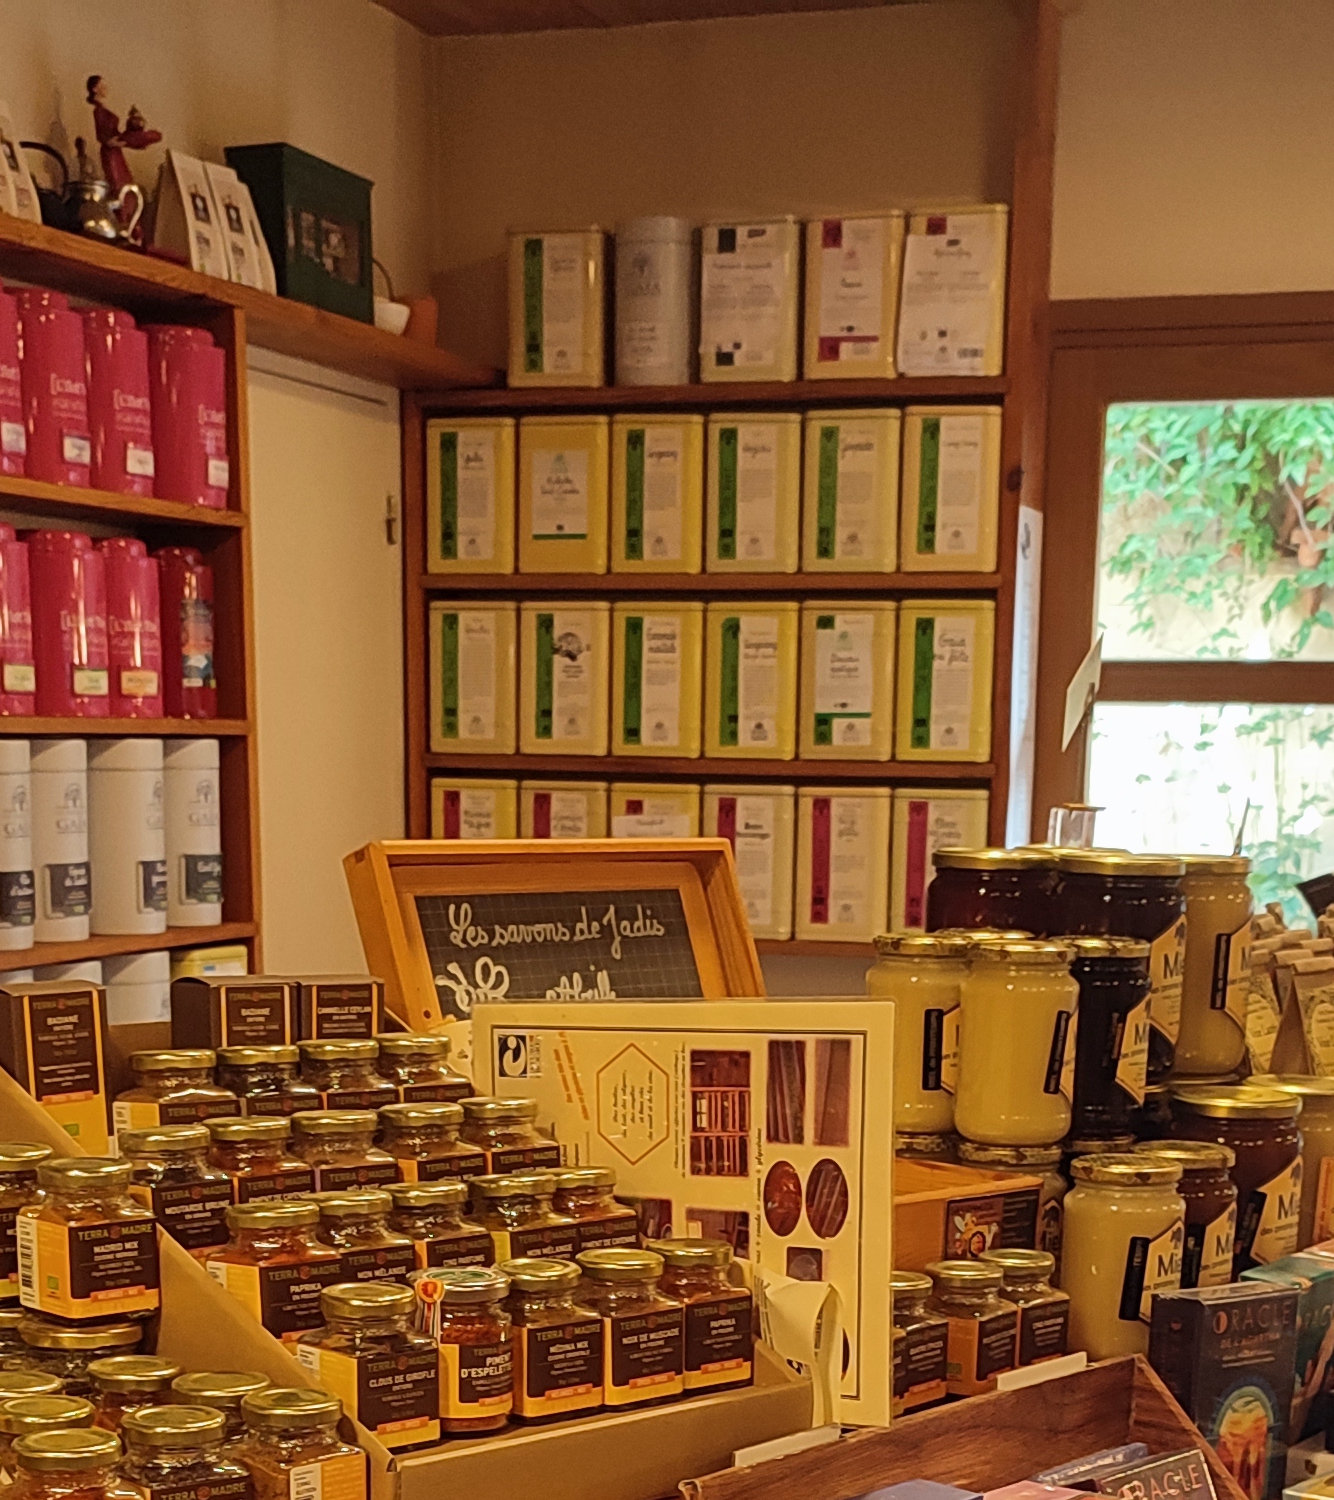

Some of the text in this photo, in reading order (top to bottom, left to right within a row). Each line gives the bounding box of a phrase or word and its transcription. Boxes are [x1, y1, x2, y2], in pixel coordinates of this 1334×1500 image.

[448, 903, 665, 960] Les savons de Jadis
[290, 1283, 322, 1294] PAPRIKA
[1213, 1302, 1291, 1336] ORACLE
[369, 1369, 436, 1389] CLOUS DE GIROFLE
[210, 1481, 246, 1496] MADRE
